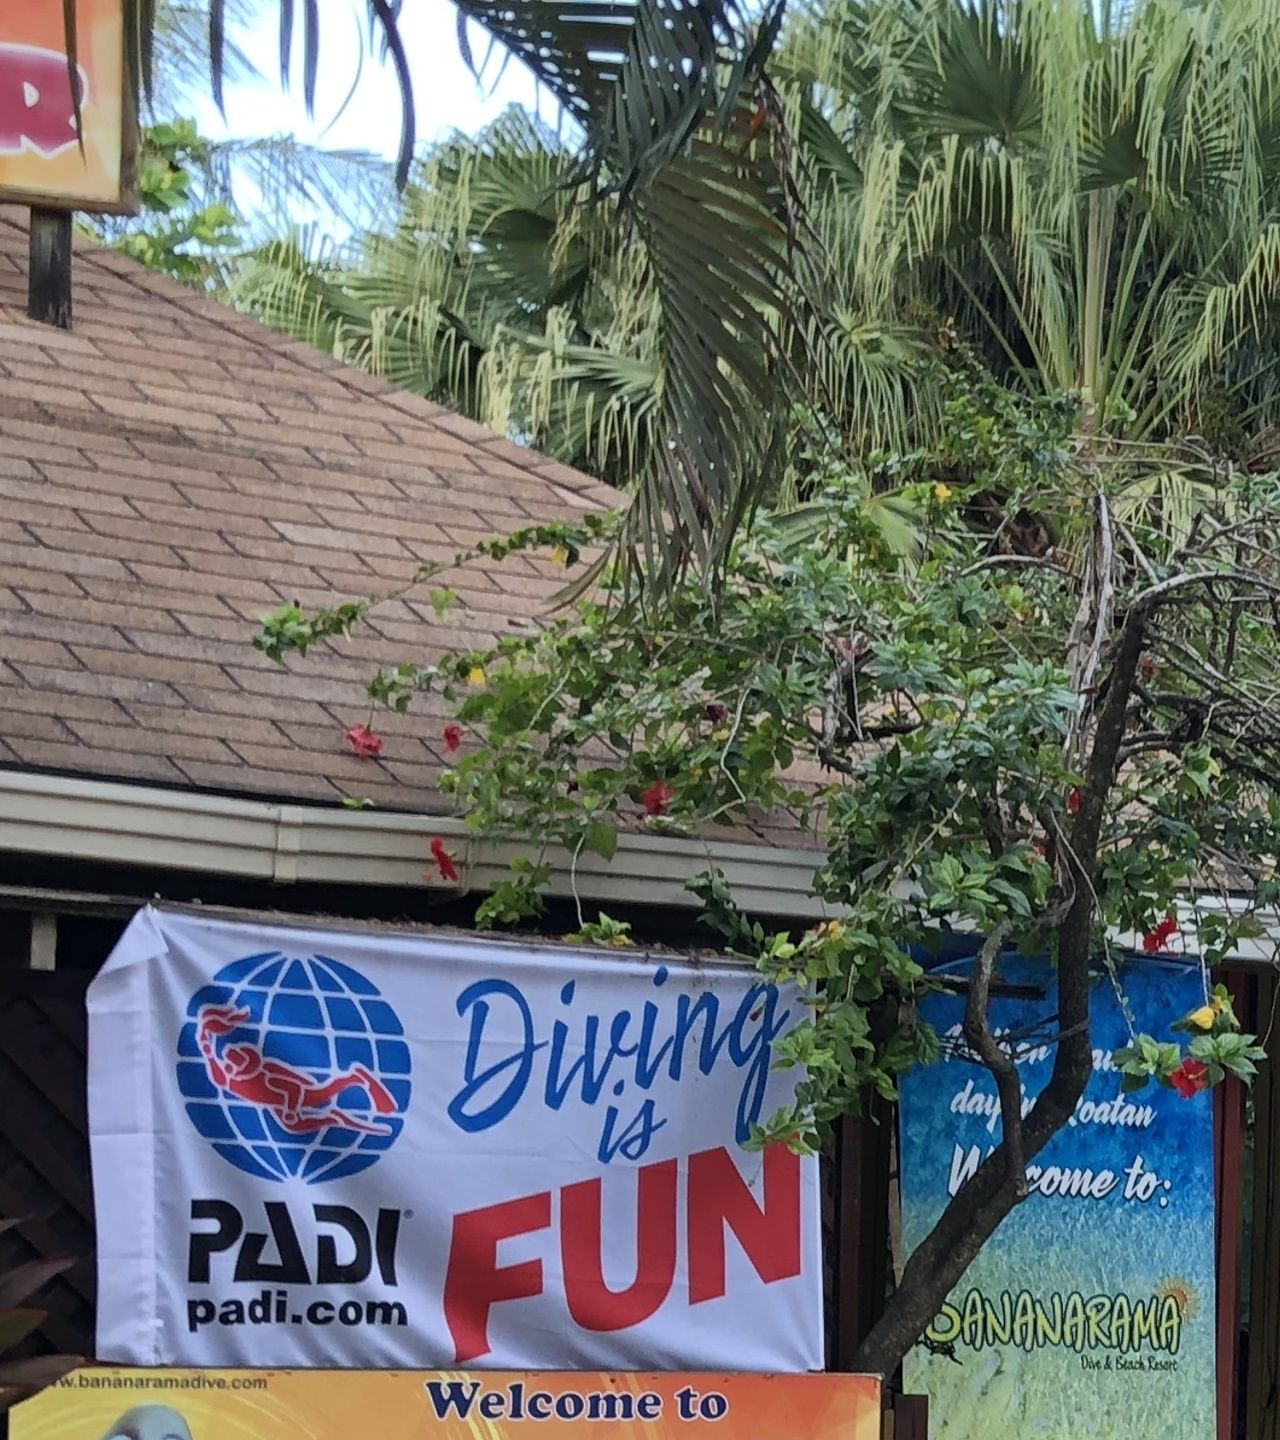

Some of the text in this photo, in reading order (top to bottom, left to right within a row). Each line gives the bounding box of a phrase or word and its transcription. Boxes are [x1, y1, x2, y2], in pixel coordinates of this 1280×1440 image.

[447, 966, 790, 1146] Diving
[598, 1079, 667, 1164] is
[1124, 1154, 1172, 1207] to:
[188, 1200, 402, 1287] PADI
[443, 1134, 801, 1364] FUN
[187, 1290, 408, 1333] padi.com
[1081, 1354, 1178, 1372] Dive & Beach Resort
[426, 1381, 728, 1423] Welcome to
